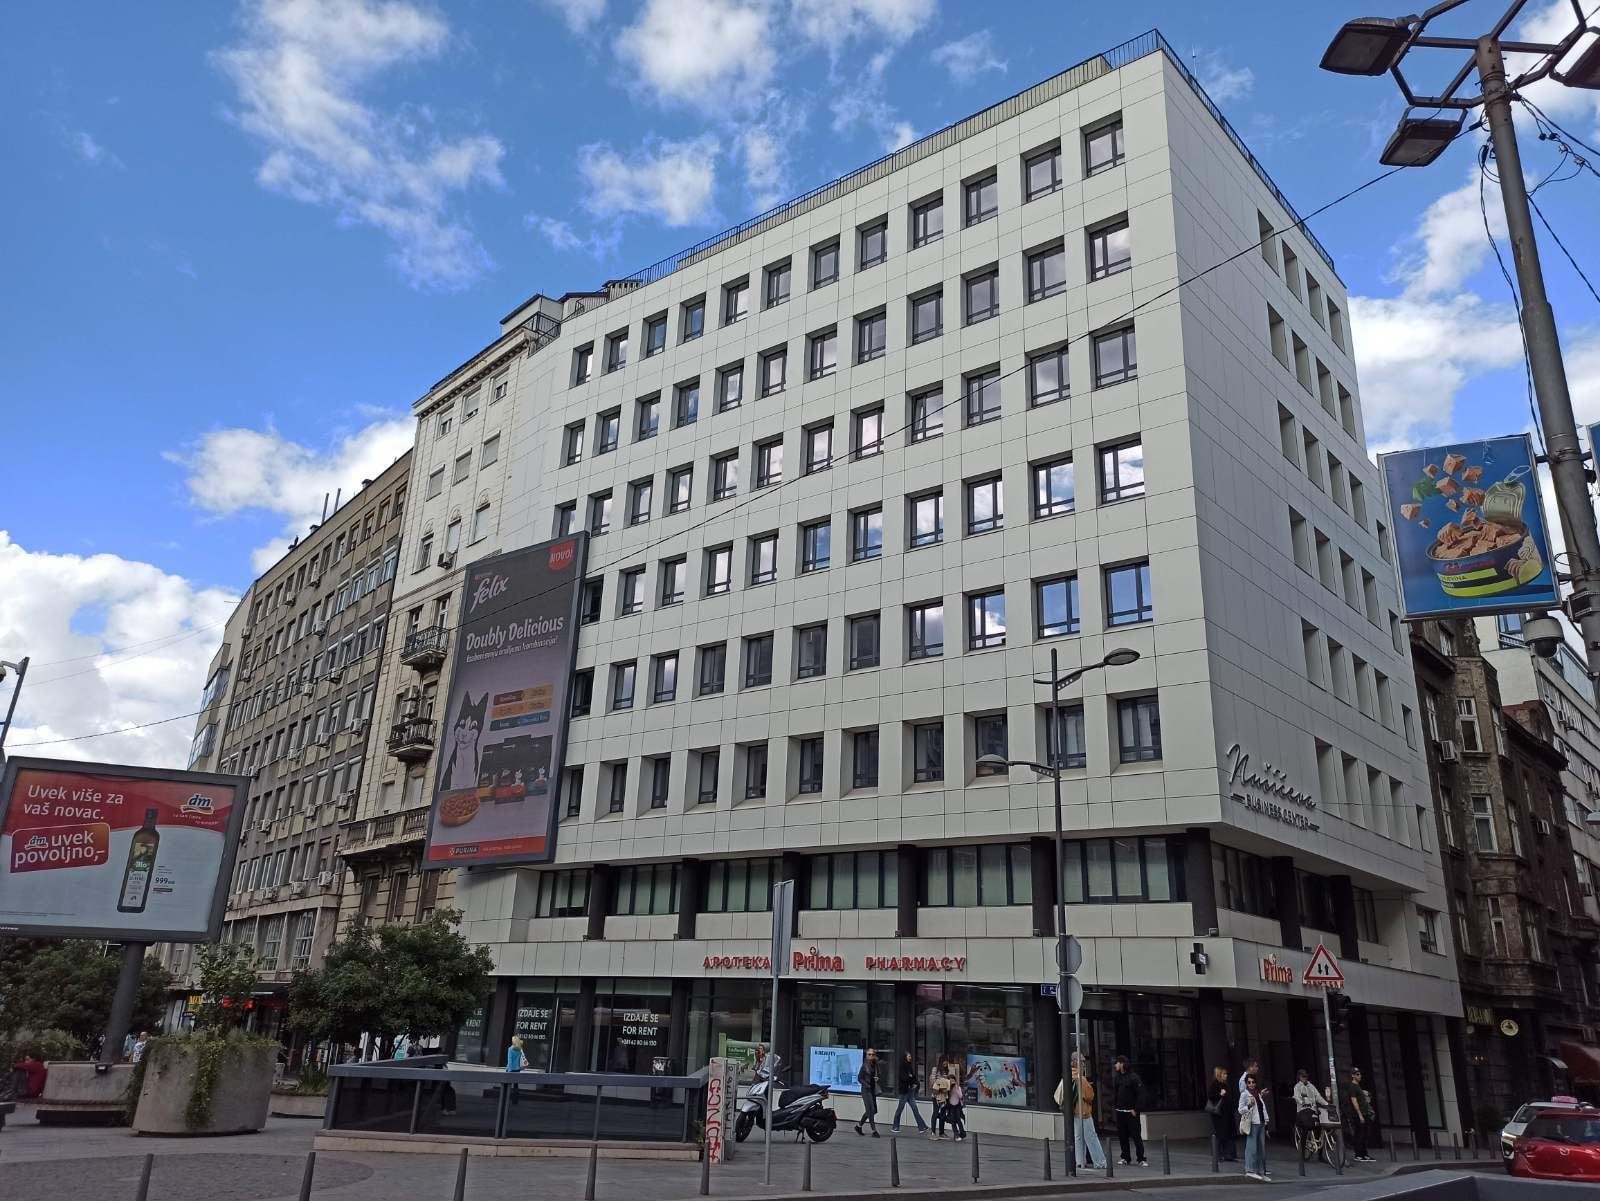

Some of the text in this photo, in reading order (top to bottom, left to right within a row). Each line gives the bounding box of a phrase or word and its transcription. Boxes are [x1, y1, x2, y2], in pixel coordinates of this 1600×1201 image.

[550, 548, 573, 564] NOVO!
[466, 616, 564, 651] Doubly Delicious
[28, 784, 124, 804] Uvek više za
[189, 794, 212, 807] dm
[24, 802, 104, 819] vaš novac.
[1245, 793, 1309, 831] BUSINESS CENTER
[51, 831, 94, 847] uvek
[456, 847, 477, 855] PURINA
[703, 946, 966, 972] APOTEKA Prima PHARMACY
[1260, 954, 1293, 984] Prima
[517, 1008, 549, 1018] IZDAJE SE
[623, 1013, 659, 1022] IZDAJE SE
[516, 1021, 547, 1031] FOR RENT
[622, 1026, 657, 1036] FOR RENT
